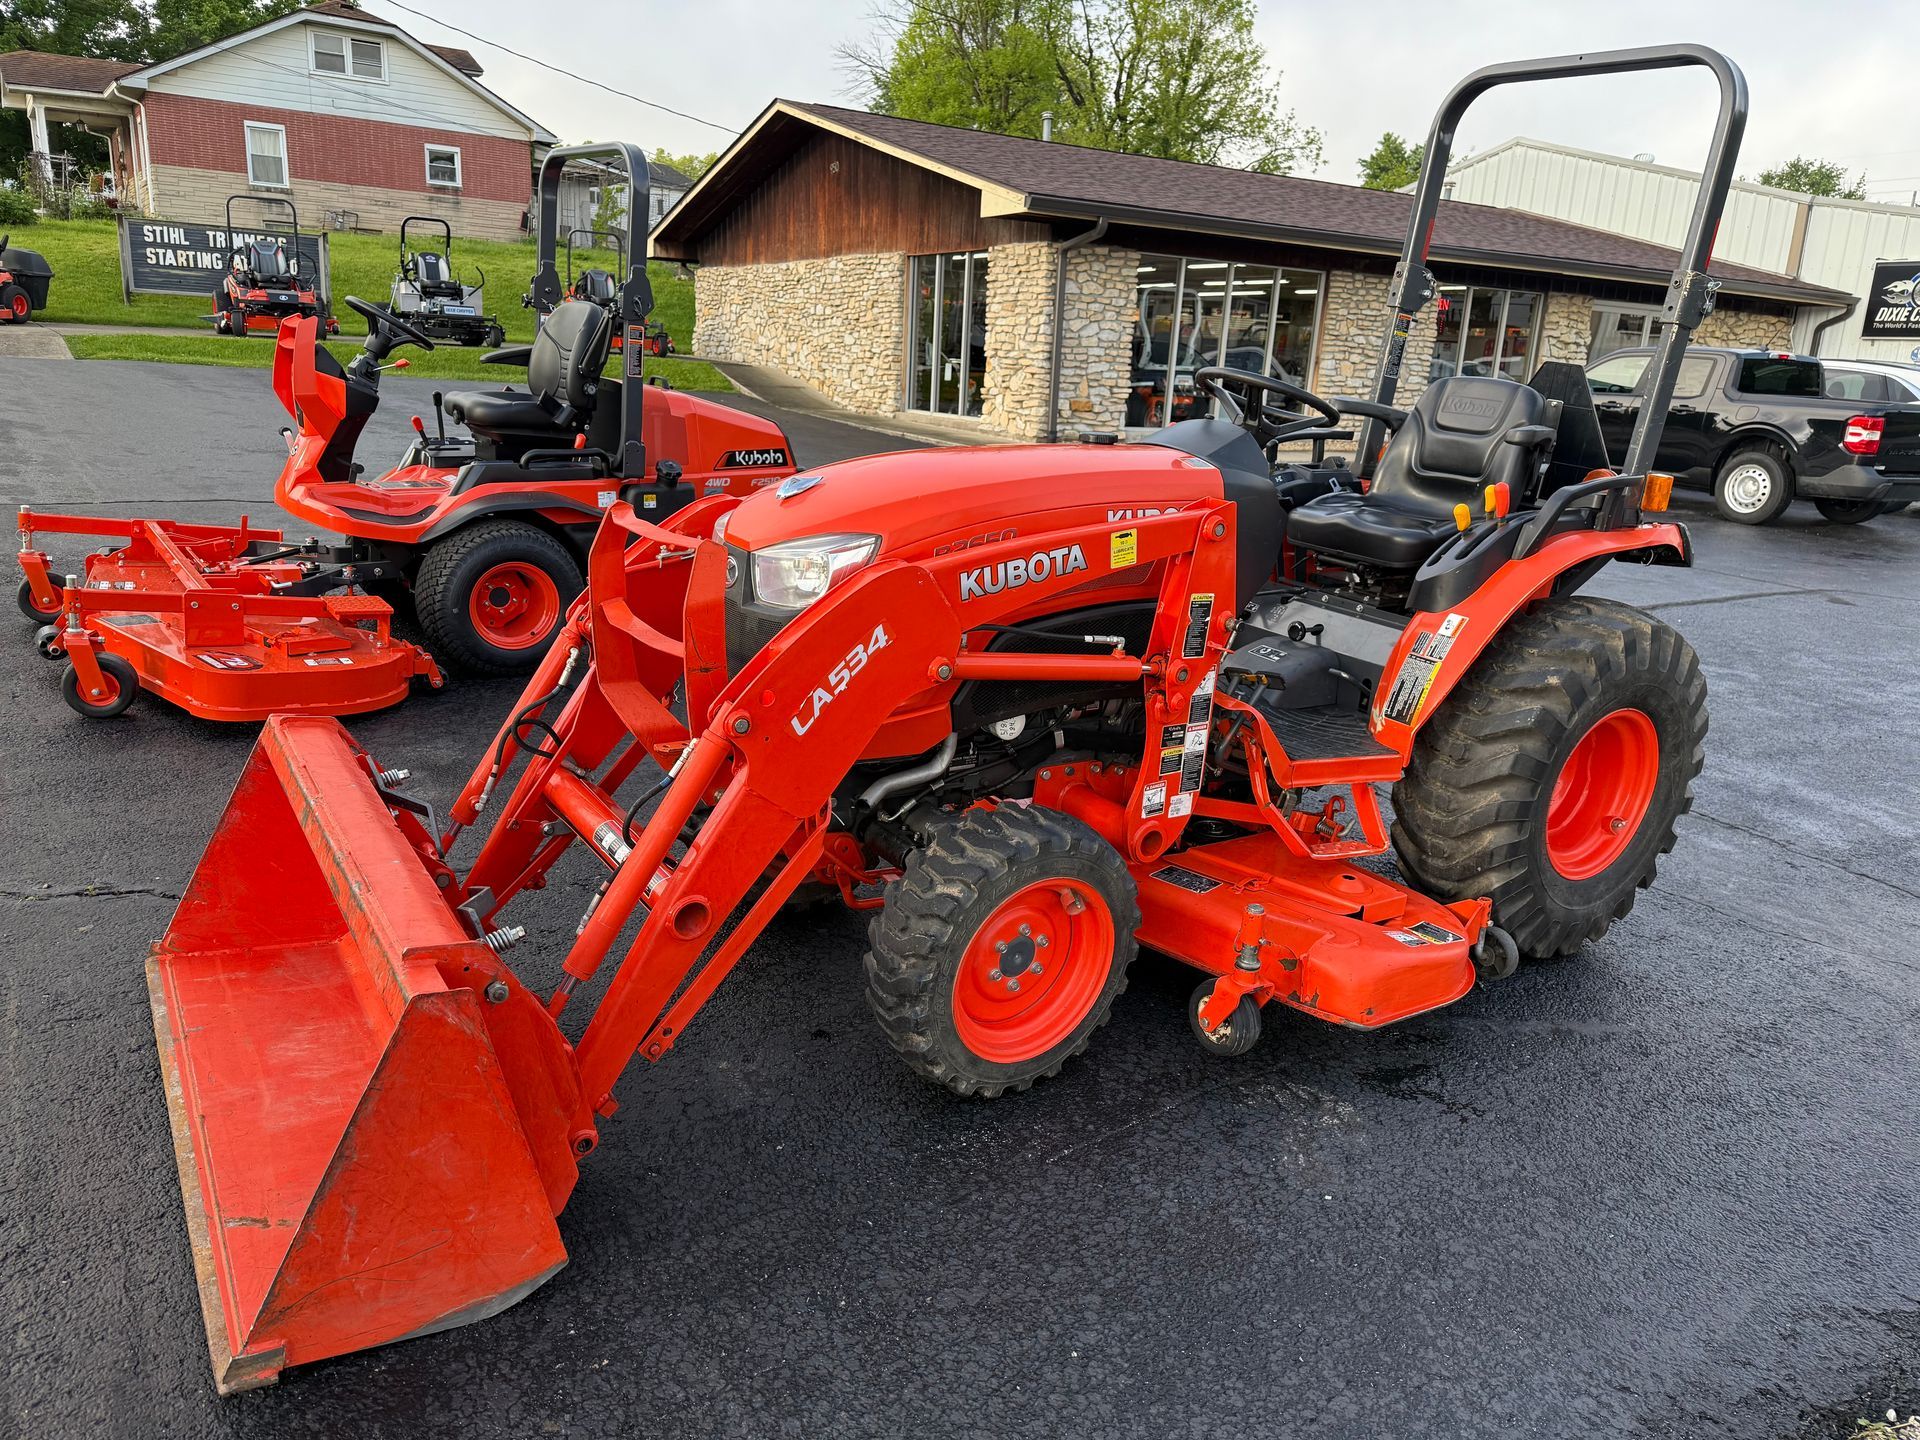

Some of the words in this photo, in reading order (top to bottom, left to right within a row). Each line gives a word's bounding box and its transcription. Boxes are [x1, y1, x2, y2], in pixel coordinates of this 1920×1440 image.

[143, 225, 190, 246] STIHL
[146, 247, 223, 270] STARTING
[1875, 307, 1912, 321] DIXIE
[735, 449, 783, 465] Kubota
[704, 477, 731, 487] 4WD
[959, 543, 1088, 602] KUBOTA
